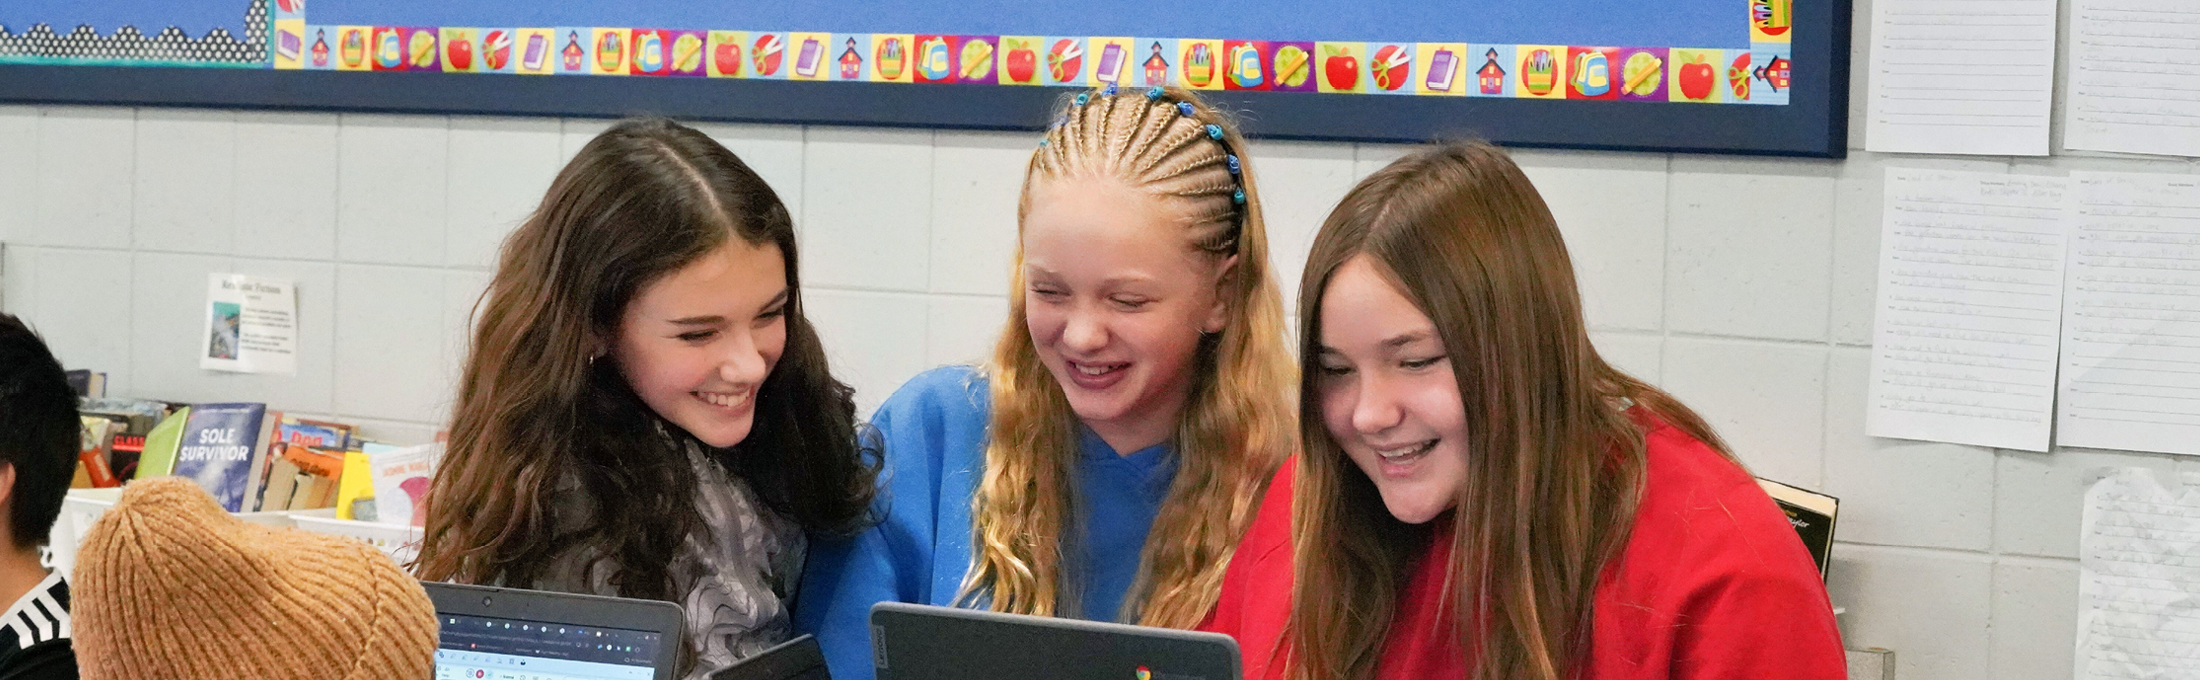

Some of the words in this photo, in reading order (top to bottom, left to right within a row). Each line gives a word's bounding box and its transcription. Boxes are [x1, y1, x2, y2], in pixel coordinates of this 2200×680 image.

[199, 428, 235, 444] SOLE
[179, 445, 250, 461] SURVIVOR
[1787, 516, 1810, 528] aylor
